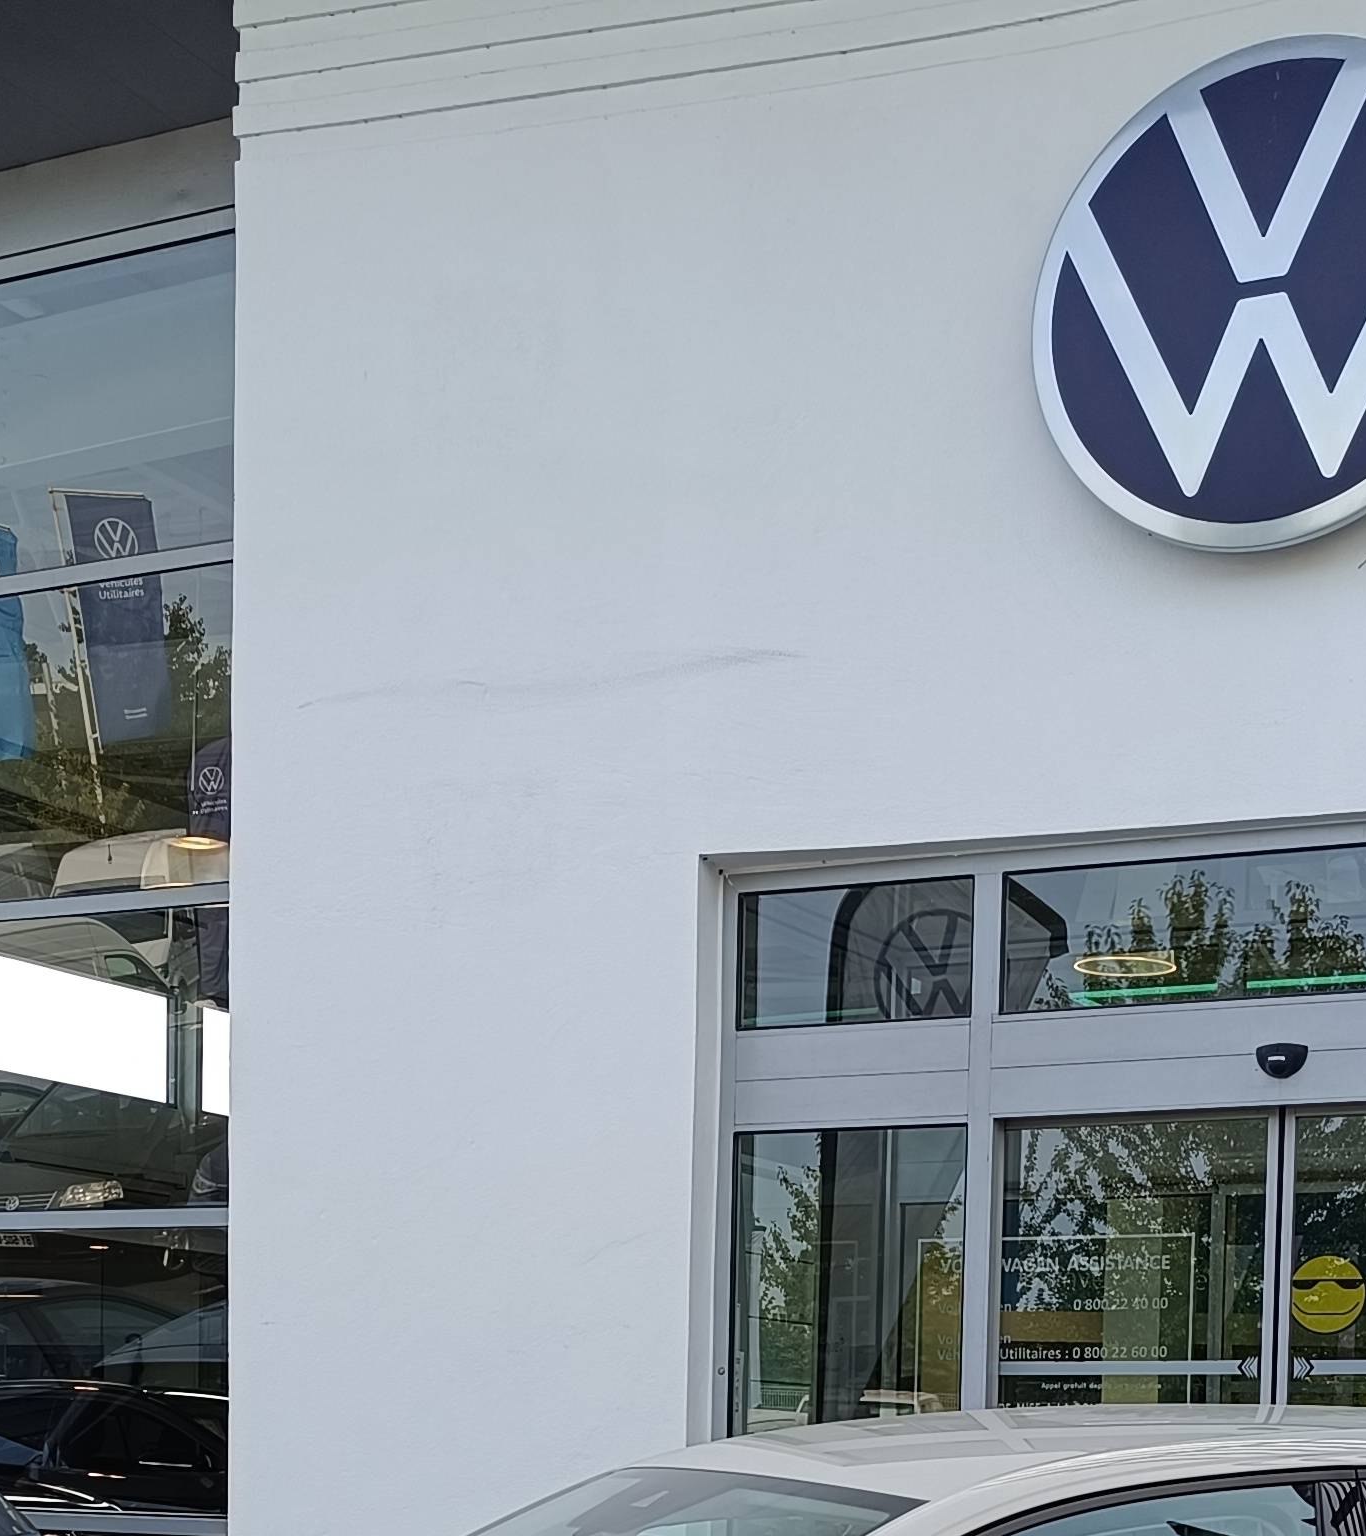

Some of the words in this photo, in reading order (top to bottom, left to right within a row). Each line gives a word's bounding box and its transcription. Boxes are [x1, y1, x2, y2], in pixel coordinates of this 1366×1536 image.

[98, 587, 145, 600] Utilitaires
[1067, 1254, 1171, 1272] ASSISTANCE
[999, 1346, 1062, 1360] Utilitaires
